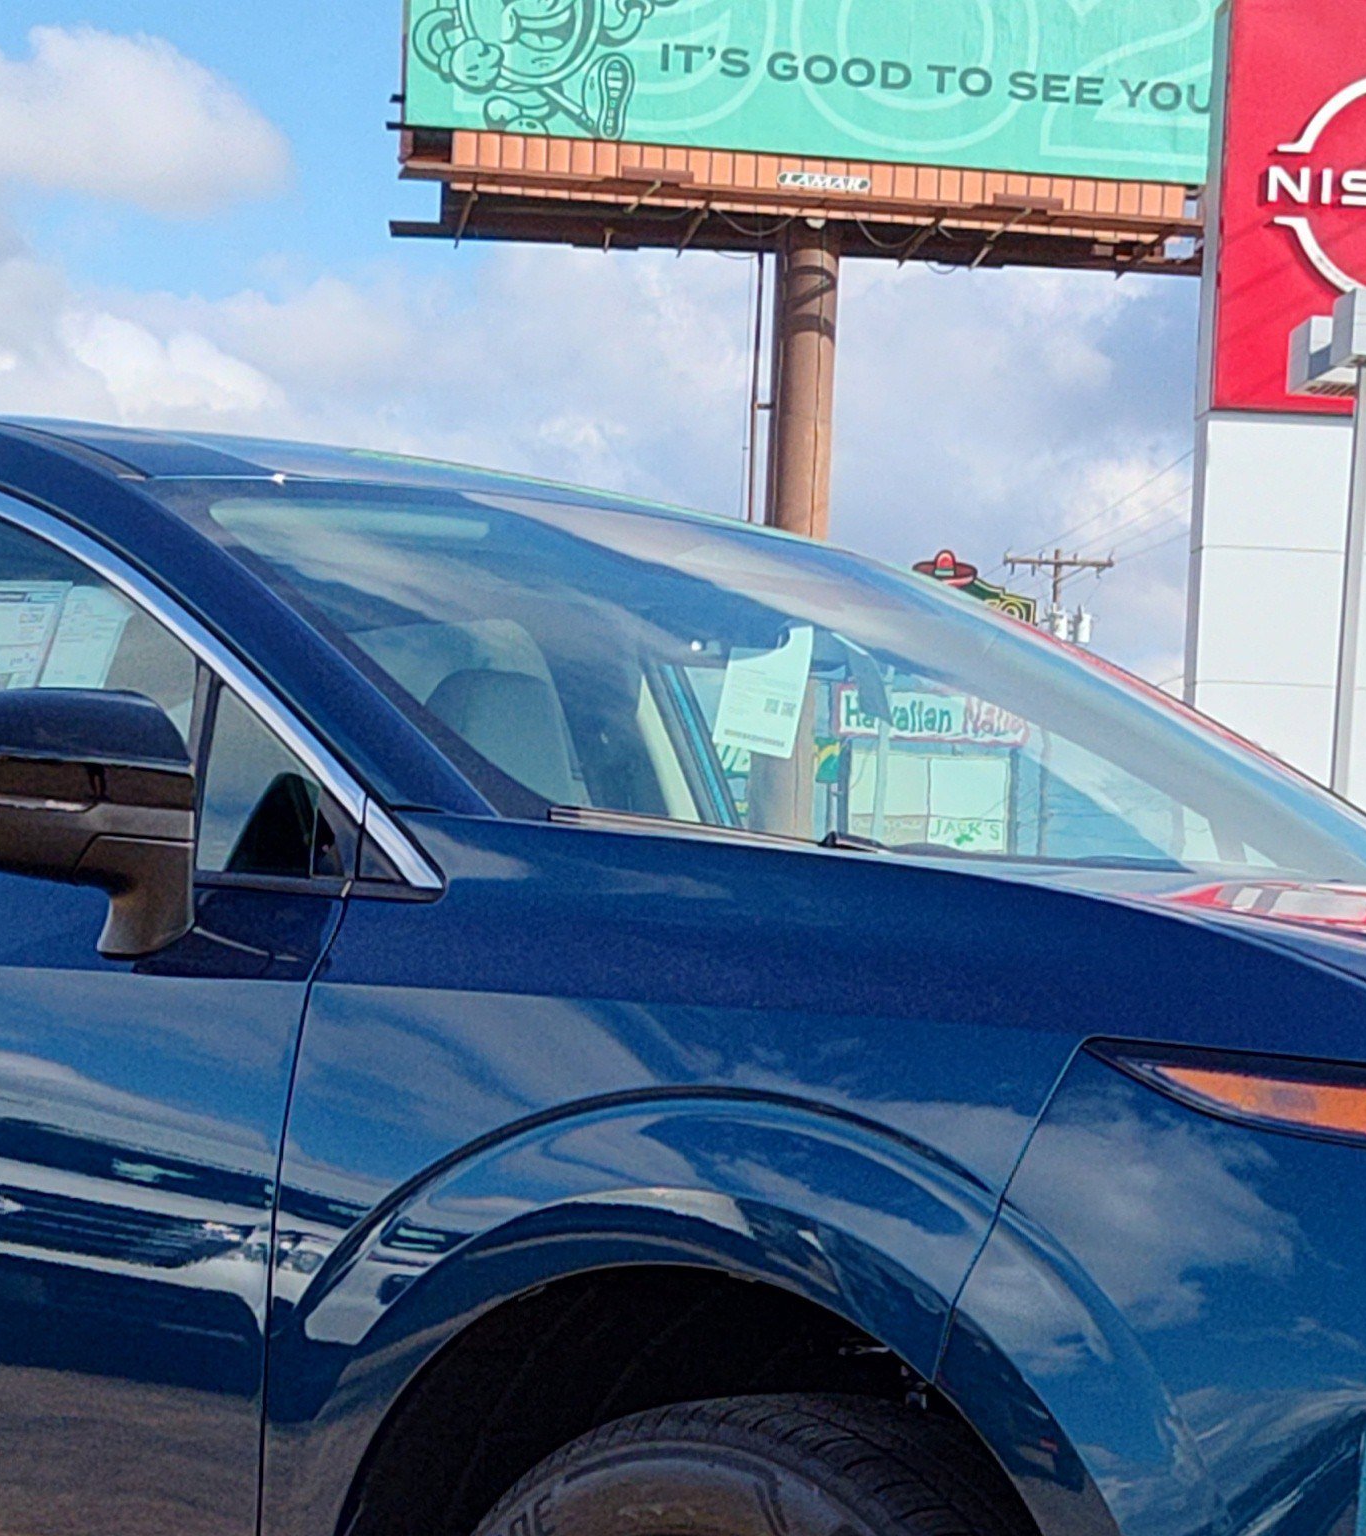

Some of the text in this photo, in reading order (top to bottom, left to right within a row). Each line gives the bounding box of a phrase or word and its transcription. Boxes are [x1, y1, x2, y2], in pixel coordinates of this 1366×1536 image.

[658, 42, 1213, 115] IT'S GOOD TO SEE YOU
[845, 694, 952, 734] Haaiian
